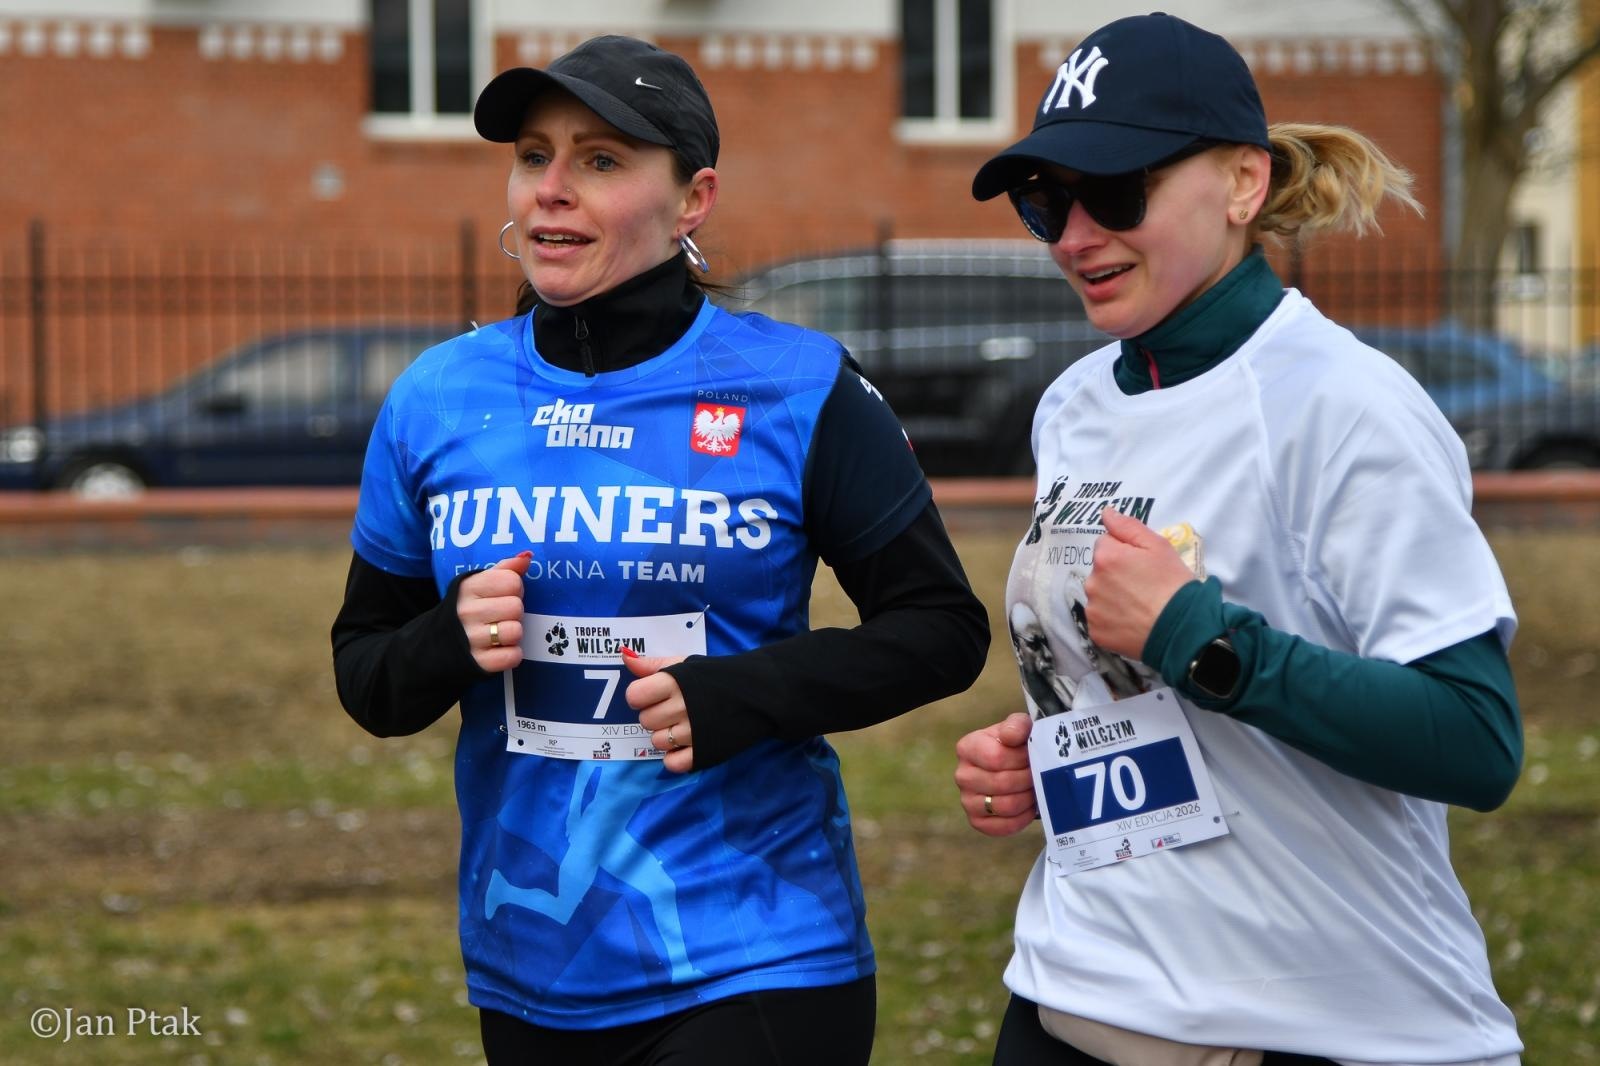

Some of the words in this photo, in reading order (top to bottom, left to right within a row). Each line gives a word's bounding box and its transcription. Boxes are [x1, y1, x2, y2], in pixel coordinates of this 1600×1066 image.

[697, 389, 749, 403] POLAND
[1073, 481, 1123, 499] TROPEM
[428, 485, 779, 550] RUNNERS
[1046, 546, 1063, 565] XIV
[1064, 546, 1094, 566] EDYC
[618, 561, 705, 583] TEAM
[575, 626, 611, 637] TROPEM
[576, 637, 646, 654] WILCZYM
[516, 720, 536, 730] 1963
[537, 724, 547, 732] m
[601, 726, 620, 735] XIV
[623, 725, 654, 736] EDY
[1072, 715, 1101, 731] TROPEM
[1075, 719, 1136, 750] WILCZYM
[1074, 755, 1146, 820] 70
[1115, 820, 1133, 832] XIV
[1135, 811, 1174, 827] EDYCJA
[1174, 802, 1201, 818] 2026
[1056, 836, 1069, 847] 1963
[1069, 836, 1075, 844] m
